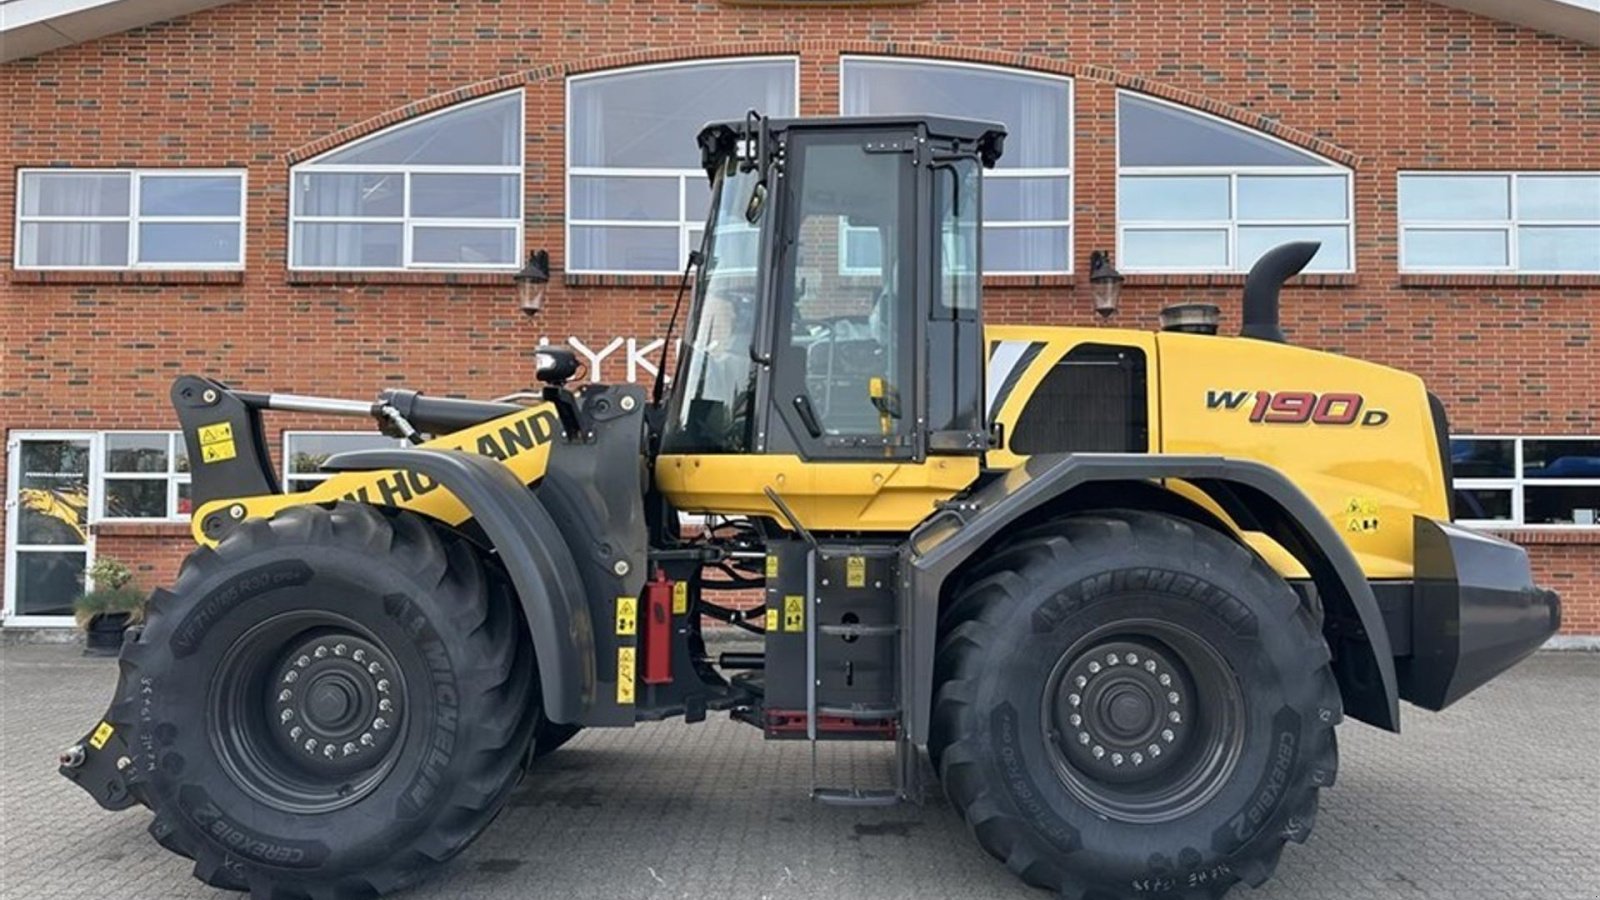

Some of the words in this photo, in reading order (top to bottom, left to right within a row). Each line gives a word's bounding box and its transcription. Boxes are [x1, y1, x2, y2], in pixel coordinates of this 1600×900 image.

[377, 411, 559, 507] HOAND
[1080, 568, 1251, 629] MICHELIN
[410, 640, 458, 809] MICHELIN
[1247, 731, 1296, 824] CEREXBIB
[210, 818, 305, 863] CEREXBIB
[1229, 811, 1253, 840] 2
